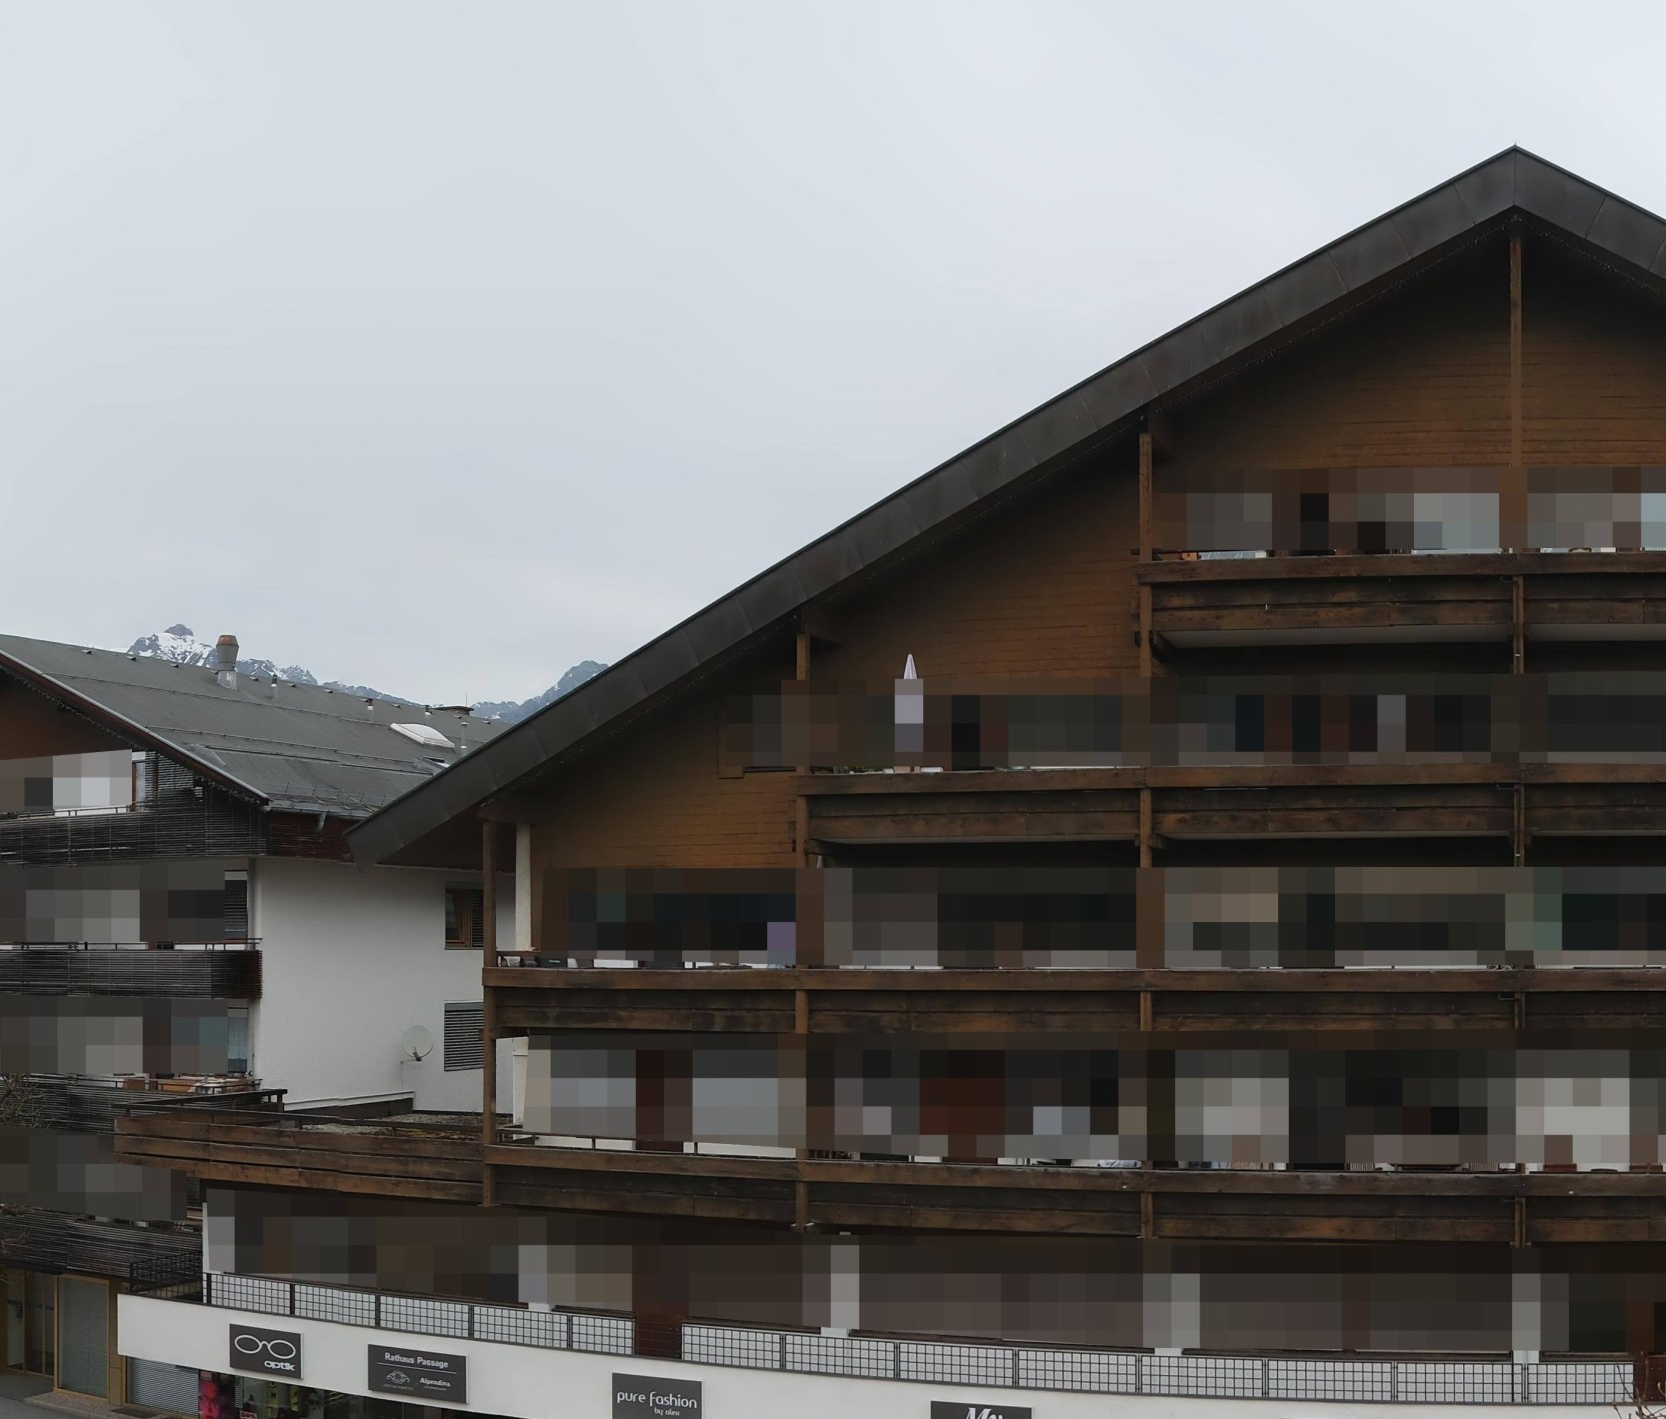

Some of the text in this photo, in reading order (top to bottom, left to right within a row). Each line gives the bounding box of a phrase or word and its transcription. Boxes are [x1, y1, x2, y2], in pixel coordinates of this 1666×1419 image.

[264, 1360, 295, 1372] optik
[384, 1352, 449, 1369] Rathaus Passage
[617, 1391, 698, 1409] pure fashion
[654, 1407, 664, 1416] by
